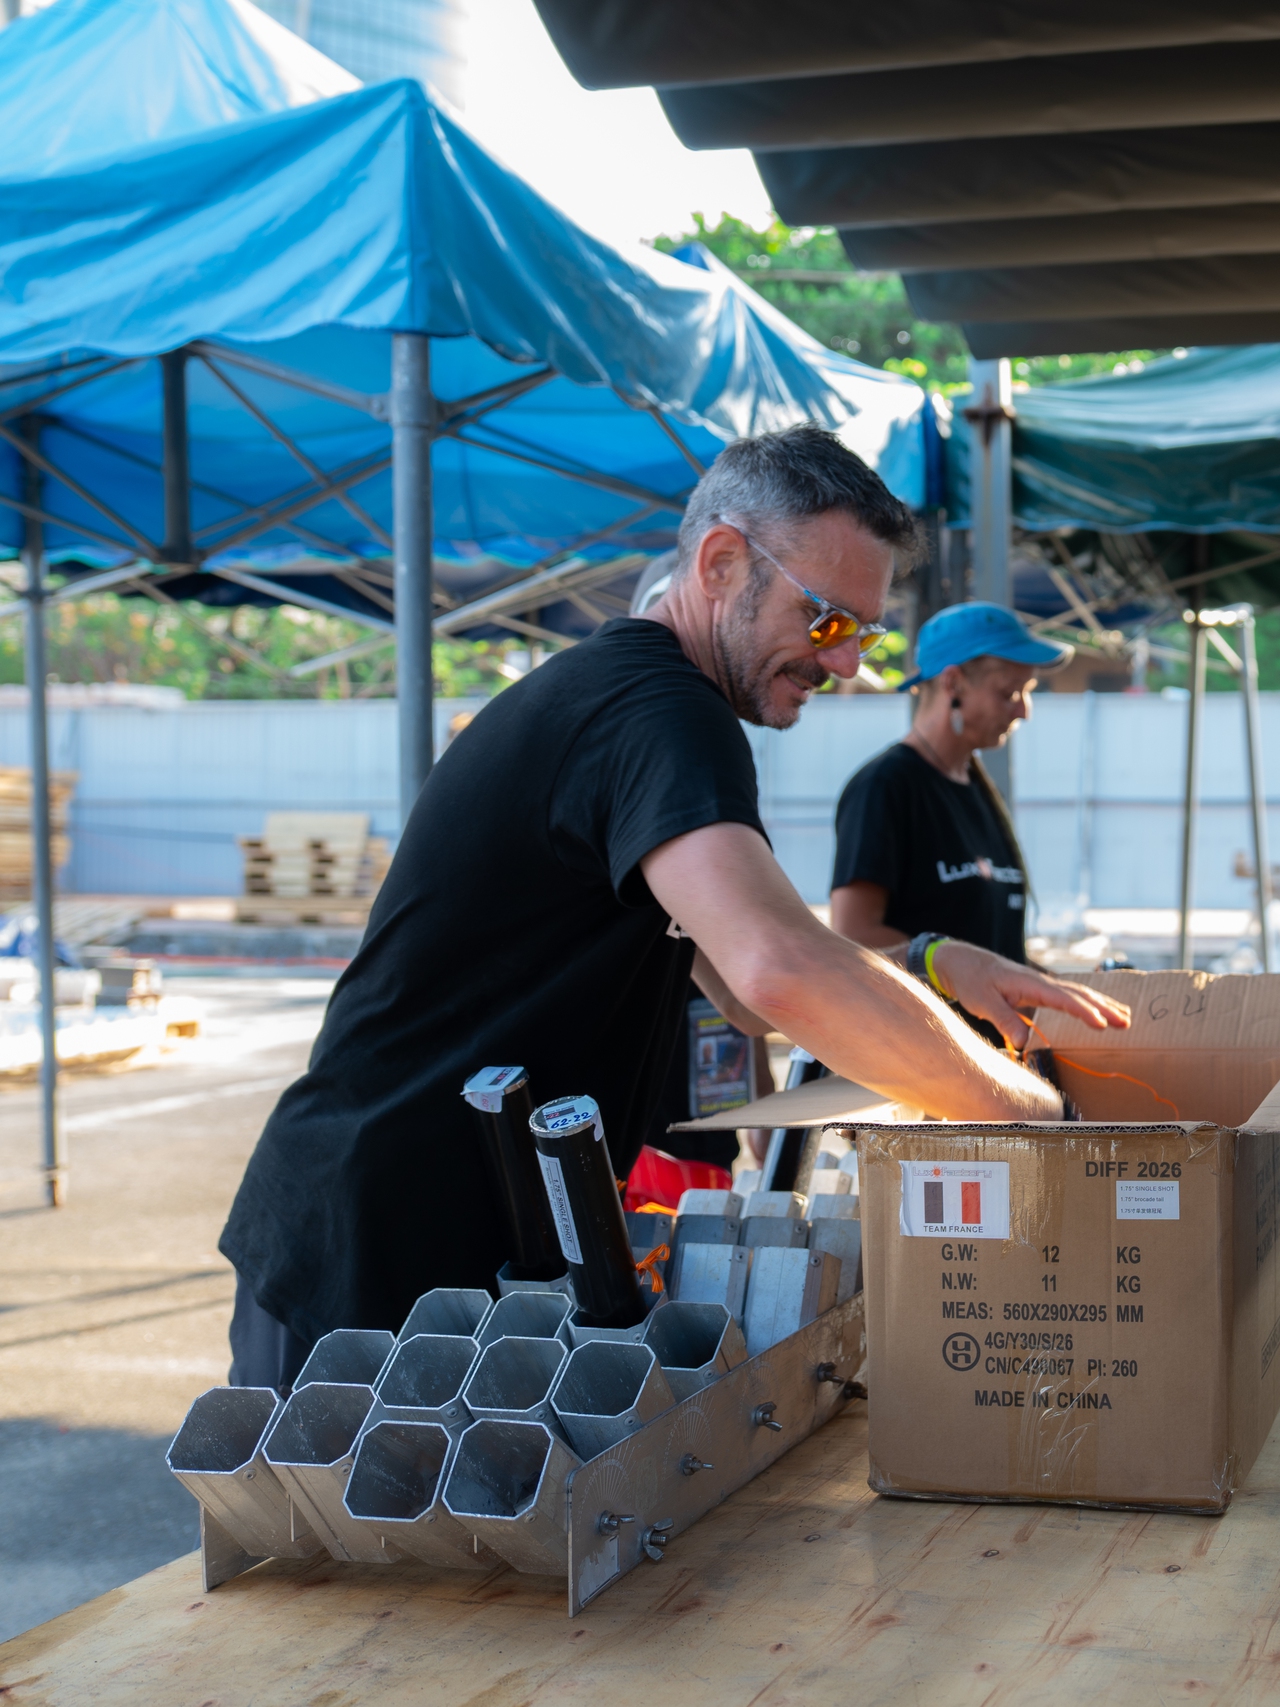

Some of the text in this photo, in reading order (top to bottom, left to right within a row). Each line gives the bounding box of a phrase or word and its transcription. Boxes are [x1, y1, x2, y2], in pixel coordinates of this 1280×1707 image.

[1085, 1161, 1182, 1178] DIFF 2026
[923, 1225, 984, 1233] TEAM FRANCE
[941, 1243, 1141, 1264] G.W: 12 KG
[941, 1272, 1141, 1293] N.W: 11 KG
[942, 1301, 1144, 1322] MEAS: 560X290X295 MM
[984, 1332, 1073, 1351] 4G/Y30/S/26
[1112, 1359, 1138, 1377] 260
[975, 1390, 1112, 1409] MADE IN CHINA
